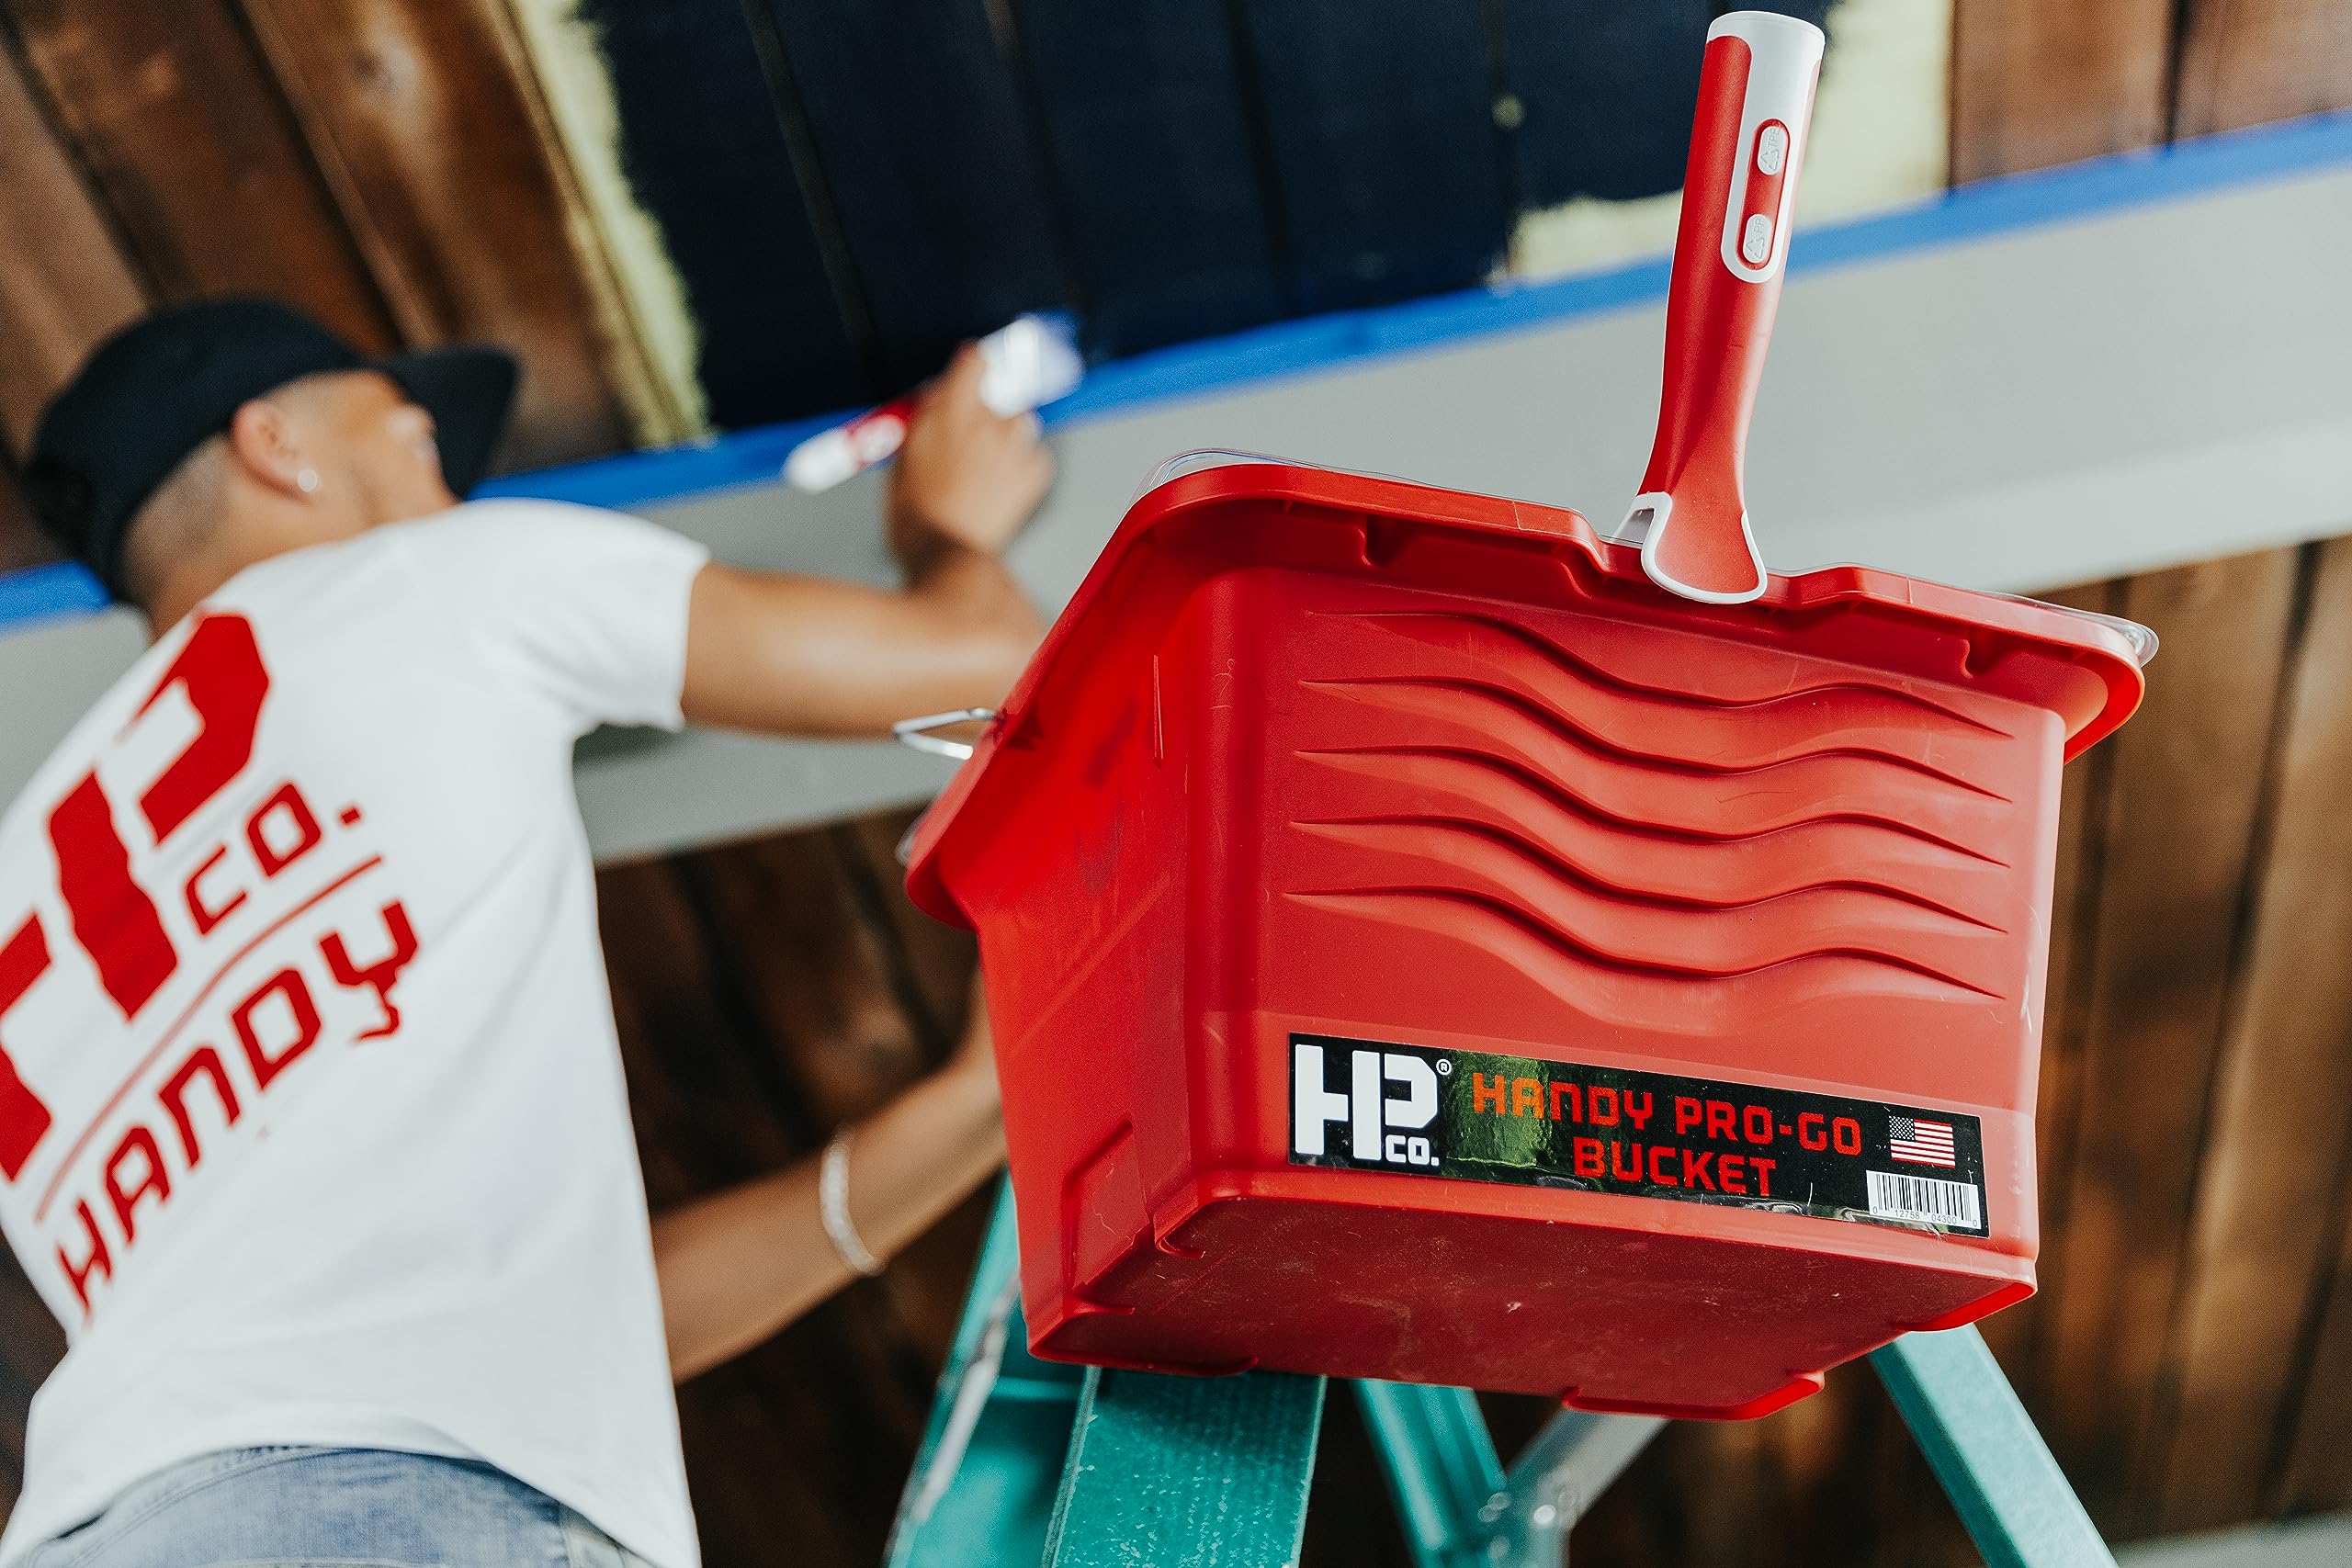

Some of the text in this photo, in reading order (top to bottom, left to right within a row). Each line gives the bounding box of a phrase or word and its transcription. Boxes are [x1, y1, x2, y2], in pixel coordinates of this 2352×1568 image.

[1768, 127, 1781, 149] TPE
[1753, 217, 1765, 234] PP
[185, 782, 363, 936] CO.
[56, 900, 419, 1316] HANDY
[1472, 1071, 1861, 1156] HANDY PRO-GO
[1385, 1134, 1440, 1167] CO.
[1572, 1135, 1776, 1198] BUCKET
[1872, 1205, 1978, 1227] 0 12758 04300 0
